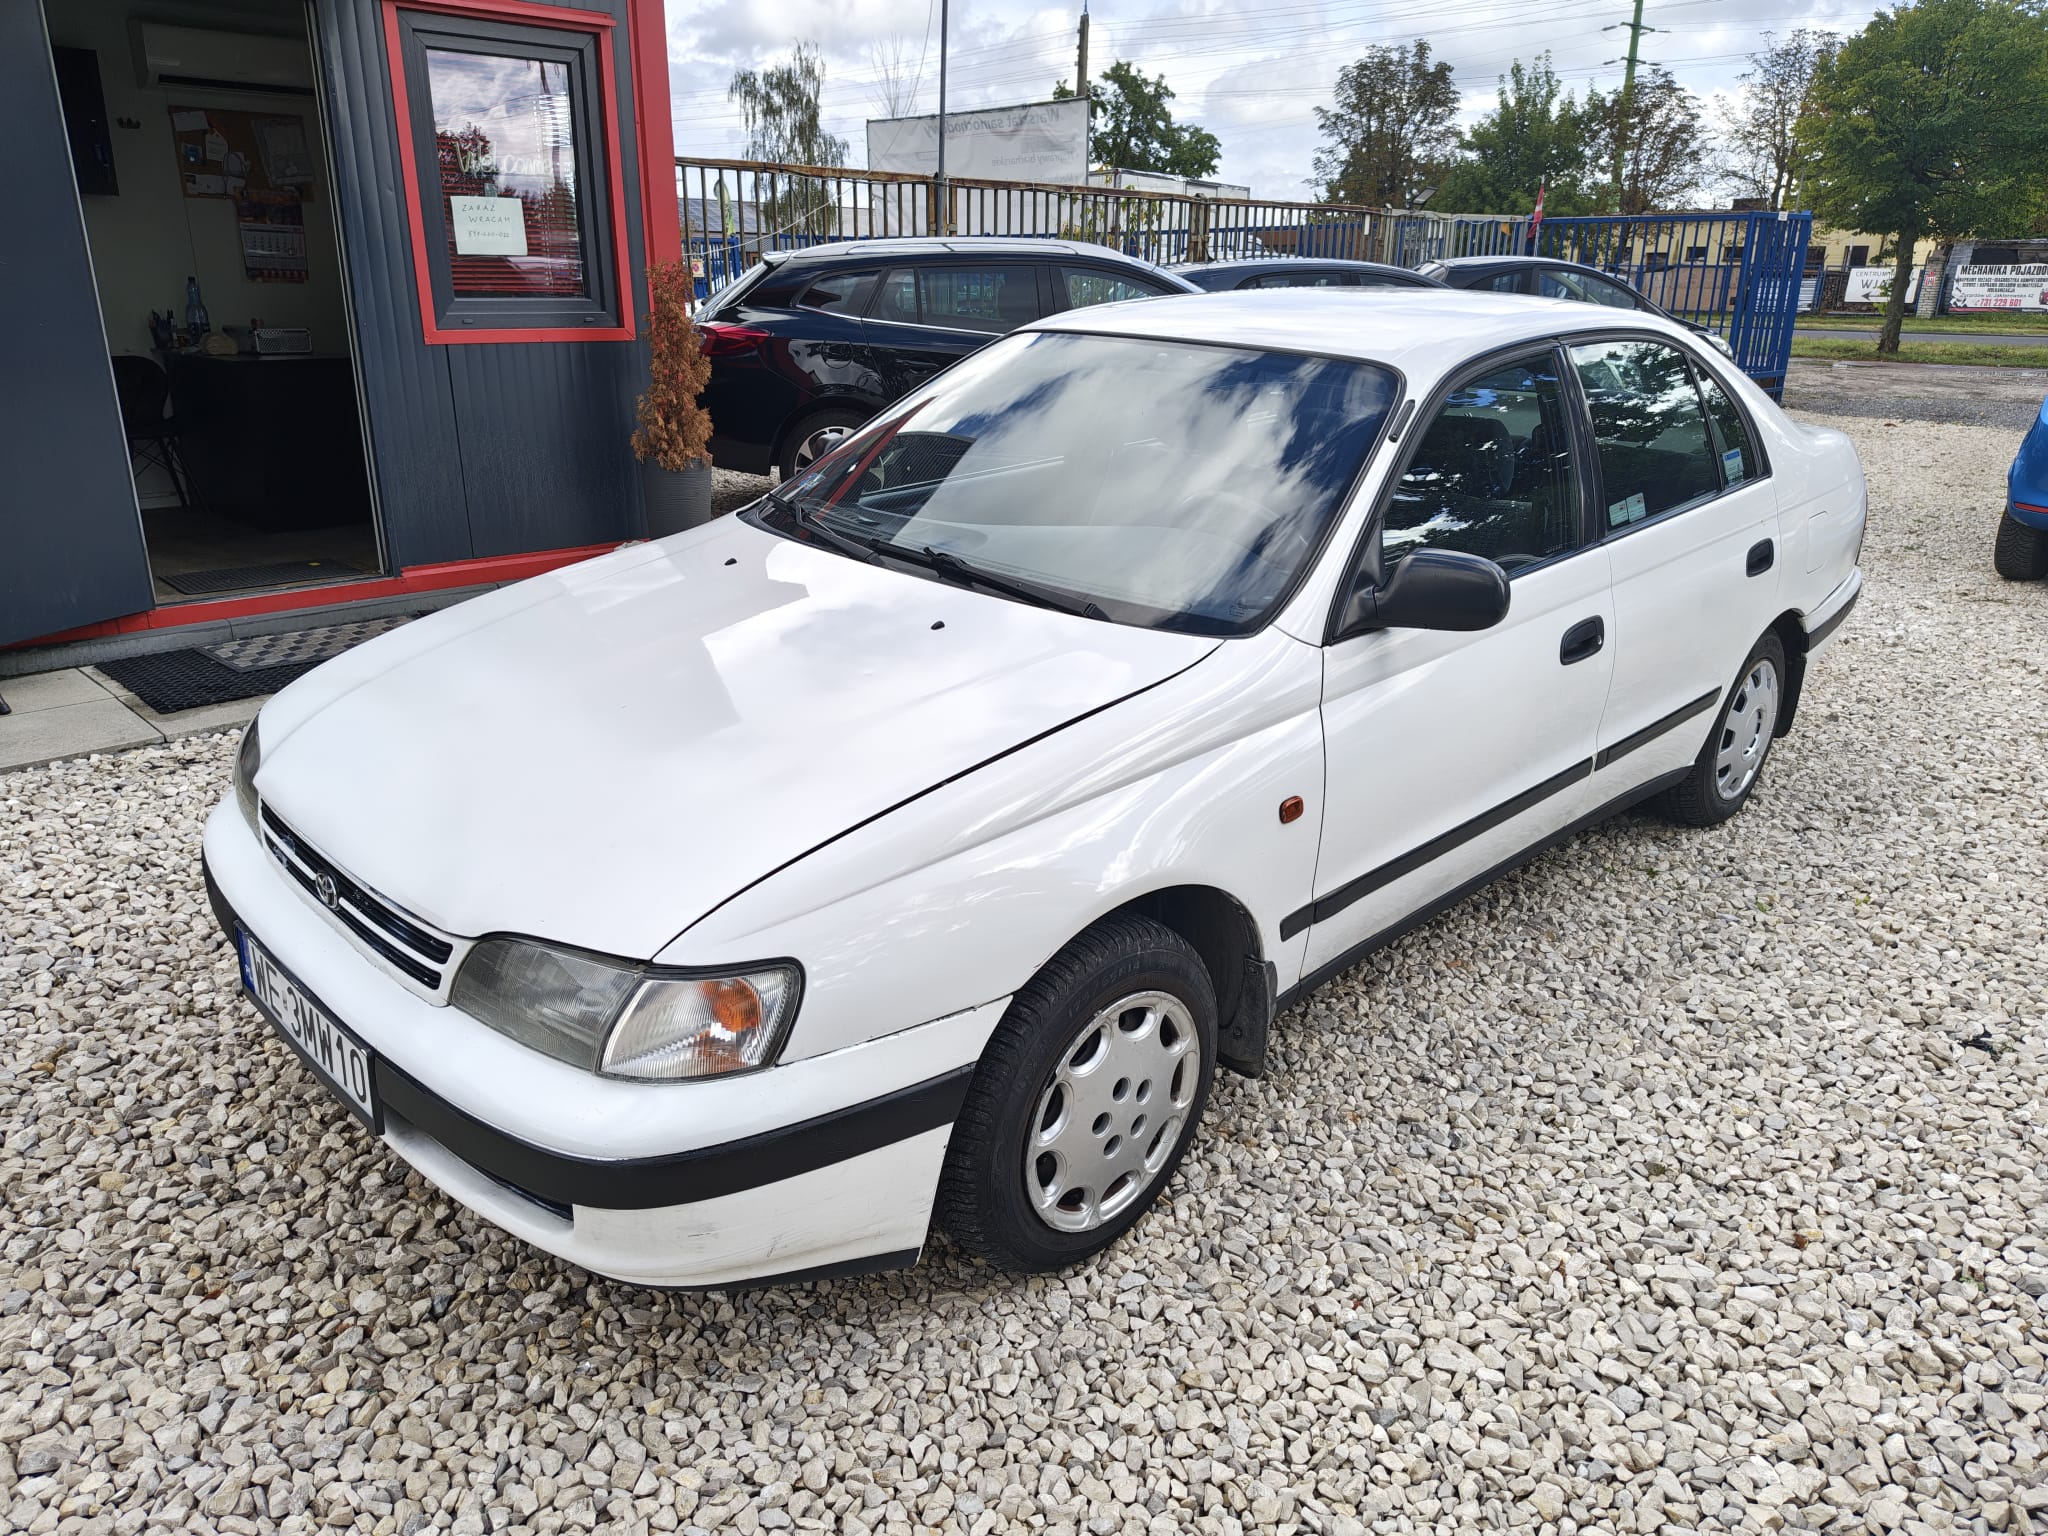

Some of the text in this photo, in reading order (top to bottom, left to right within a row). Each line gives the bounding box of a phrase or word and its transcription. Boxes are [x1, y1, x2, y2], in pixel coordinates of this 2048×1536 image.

[1961, 266, 2007, 275] MECHANIKA
[251, 945, 368, 1104] WE 3MW10
